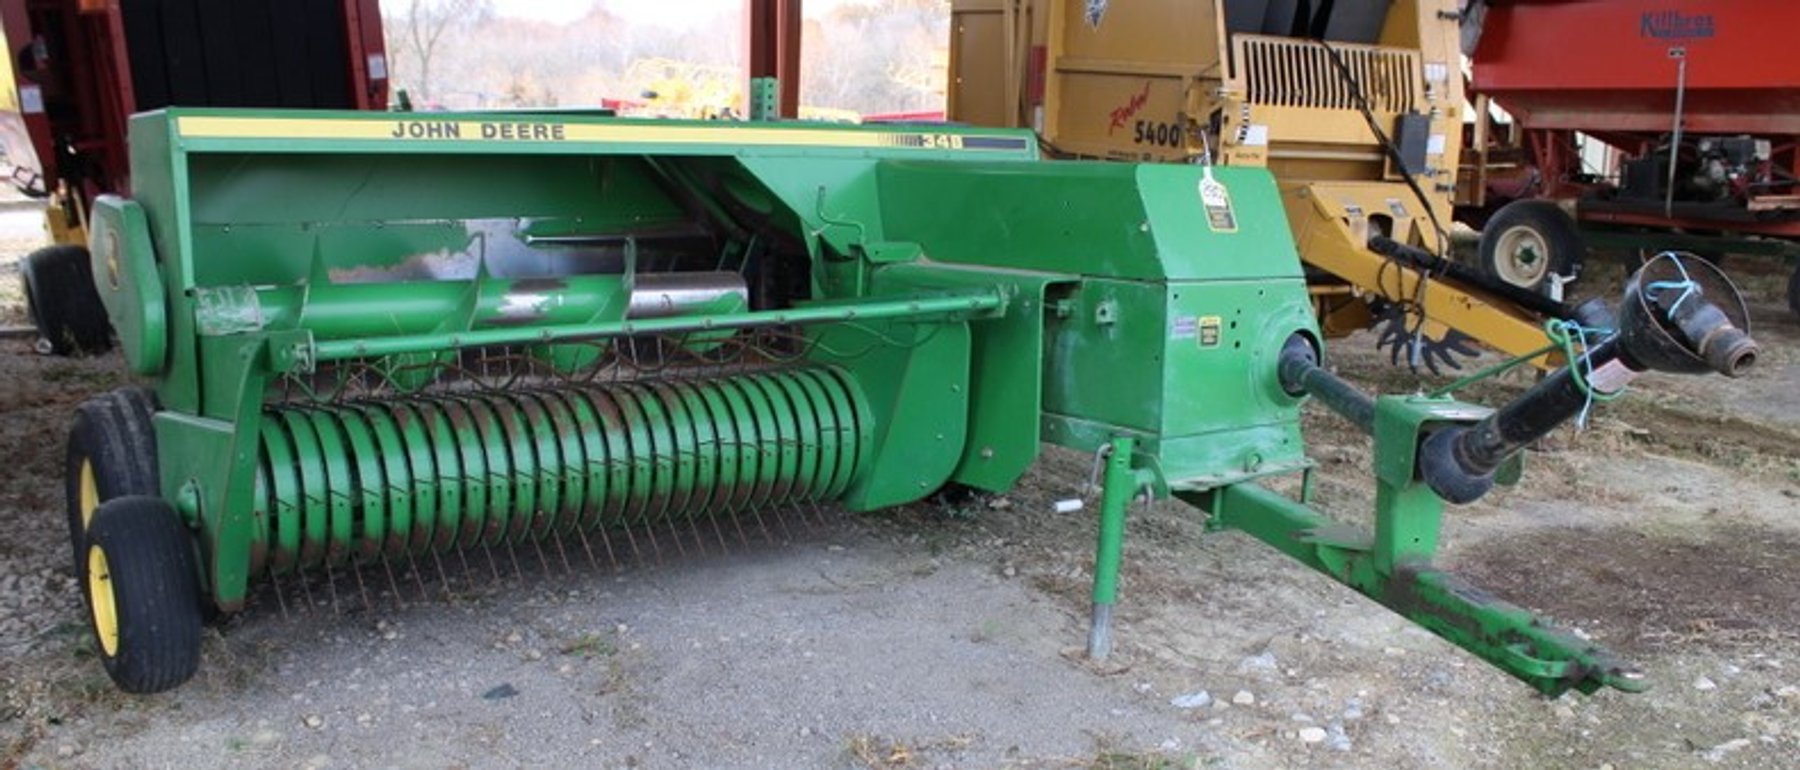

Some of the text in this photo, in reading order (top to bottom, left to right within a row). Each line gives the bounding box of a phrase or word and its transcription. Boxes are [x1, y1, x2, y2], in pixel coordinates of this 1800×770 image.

[392, 122, 565, 140] JOHN DEERE
[1134, 121, 1180, 148] 5400
